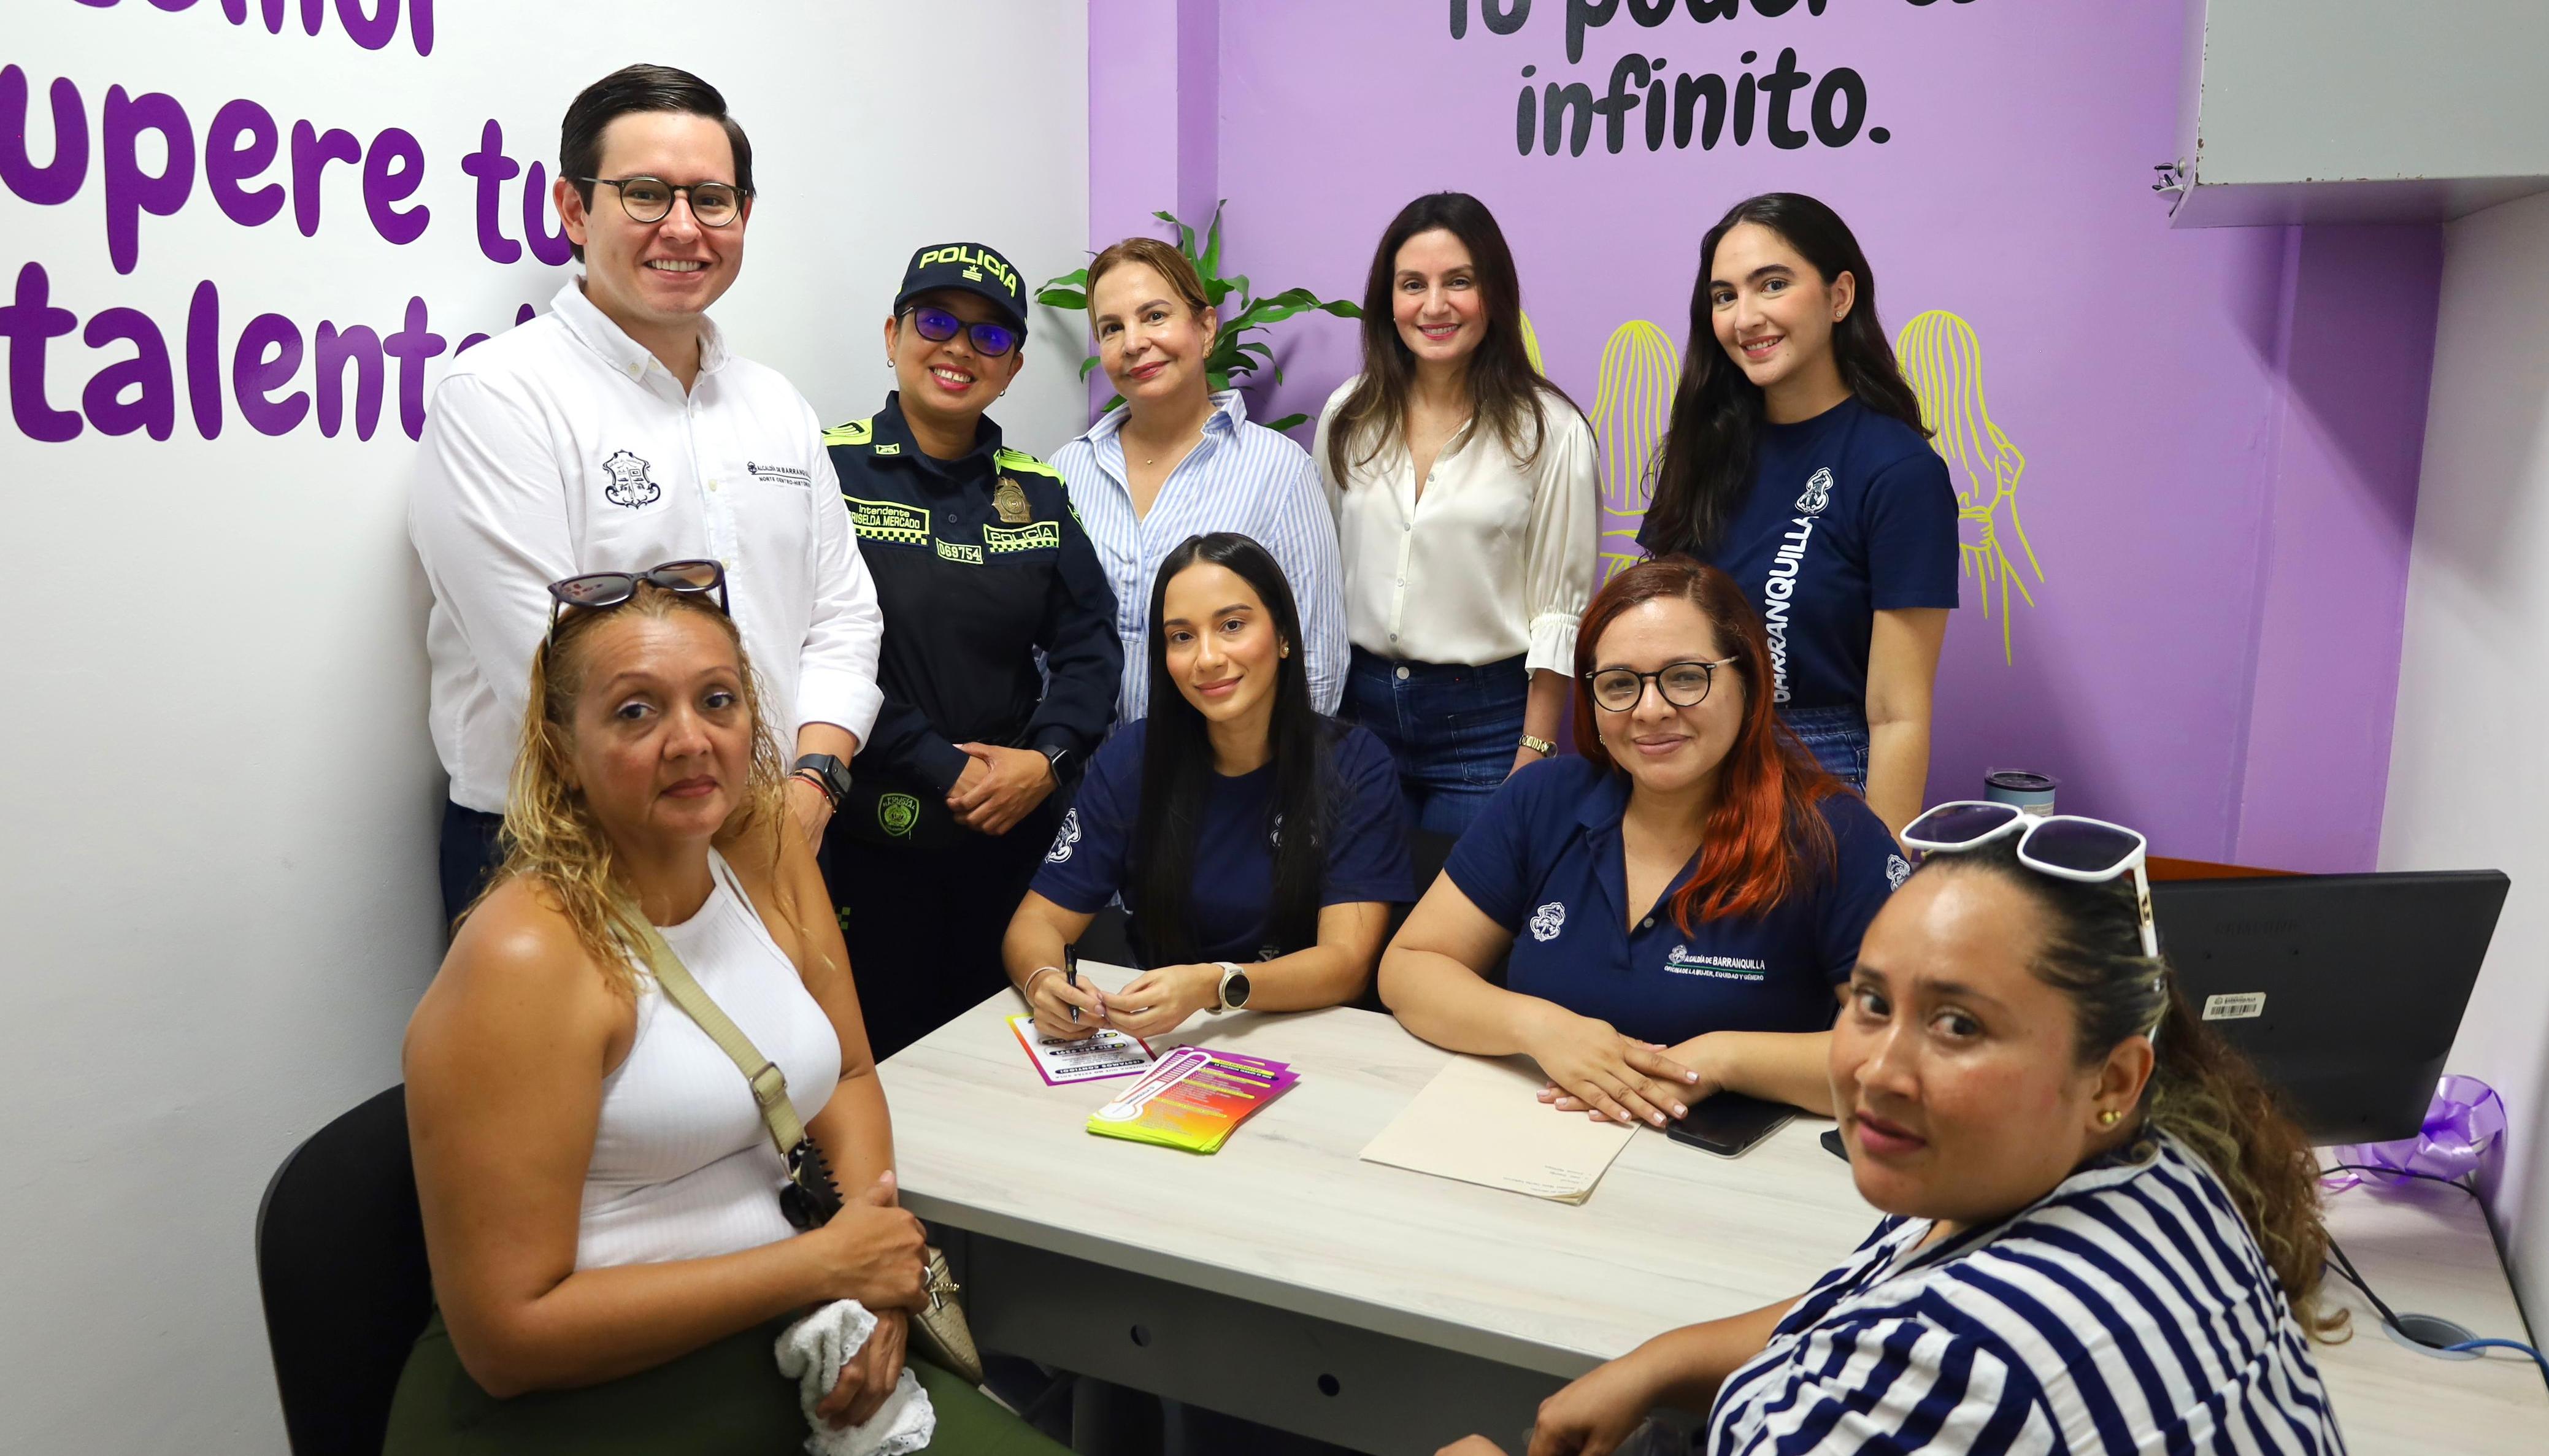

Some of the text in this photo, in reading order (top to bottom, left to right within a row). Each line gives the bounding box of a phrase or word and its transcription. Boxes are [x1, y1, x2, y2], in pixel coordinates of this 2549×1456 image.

[1517, 47, 1891, 158] infinito.
[918, 245, 1017, 298] POLICÍA
[859, 504, 910, 518] Intendente
[883, 516, 920, 529] MERCADO
[990, 526, 1053, 542] POLICÍA
[939, 543, 981, 561] 069754
[1684, 954, 1705, 964] ALCALDÍA
[1712, 956, 1765, 970] BARRANQUILLA
[1715, 971, 1738, 980] EQUIDAD
